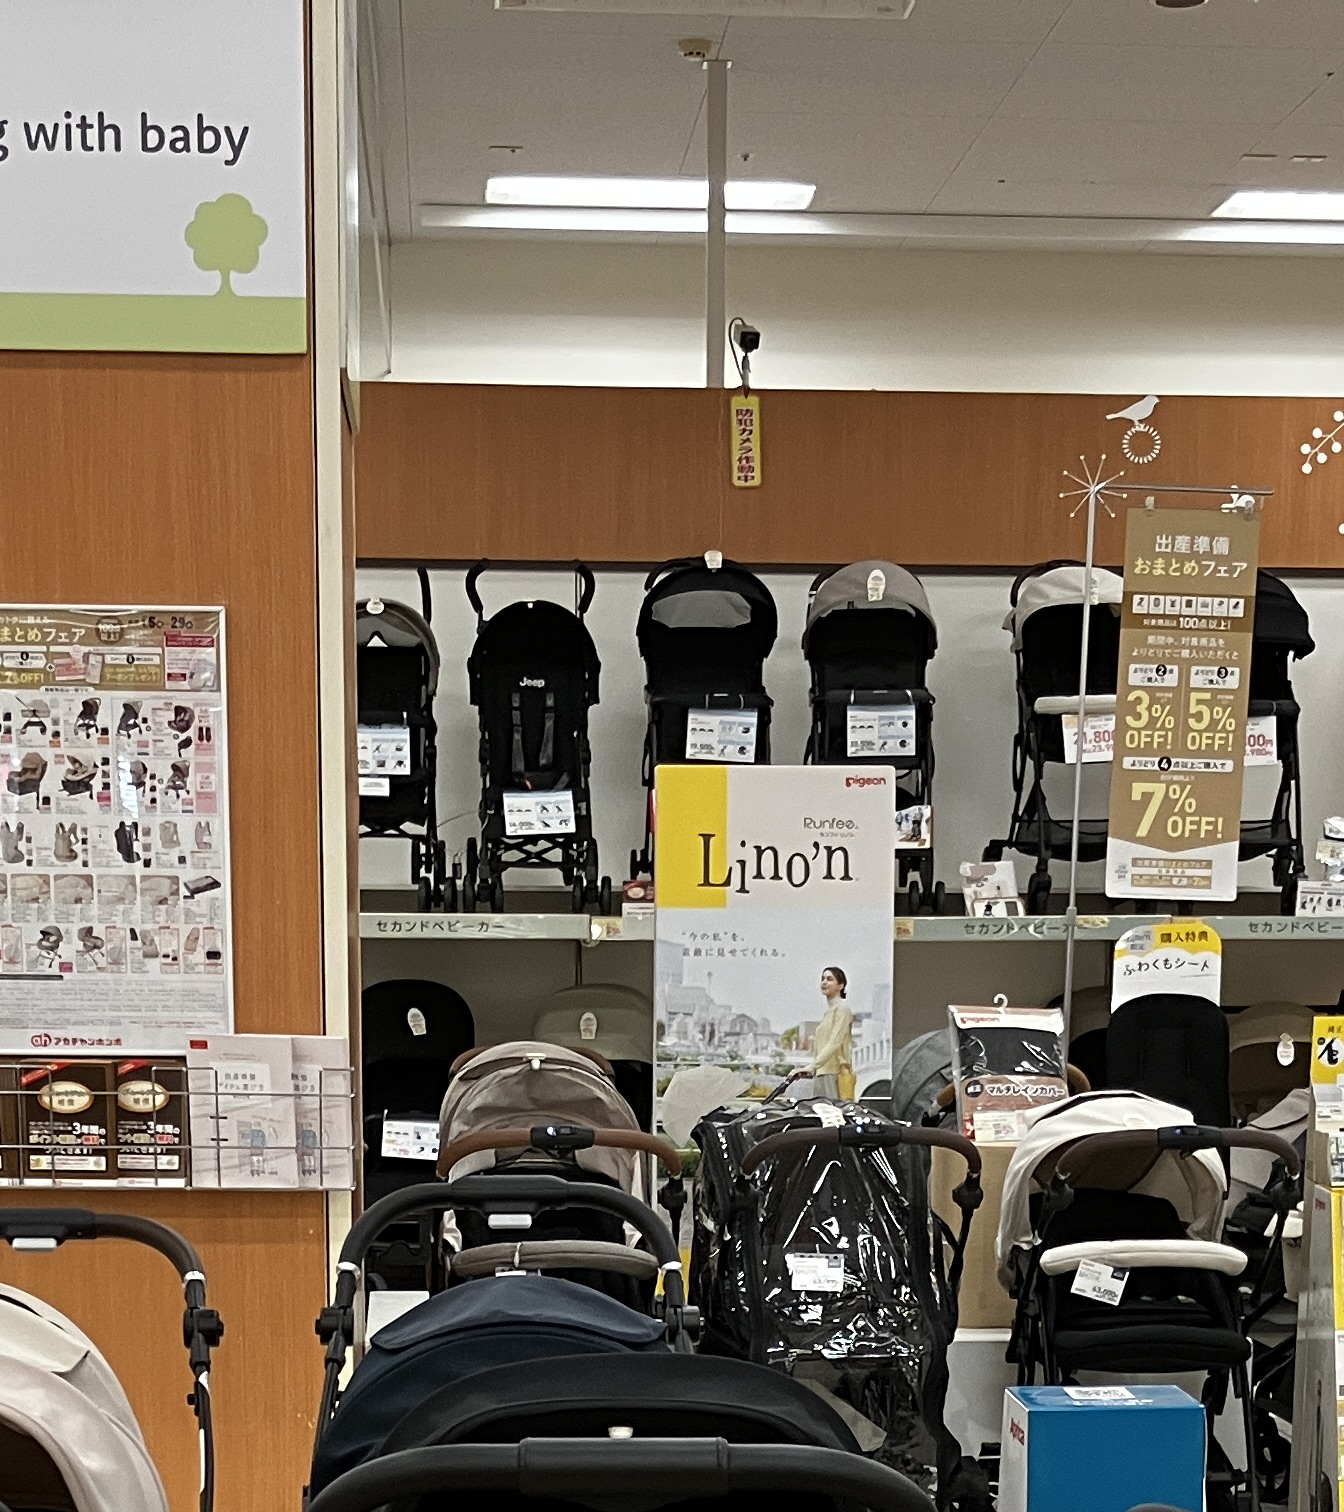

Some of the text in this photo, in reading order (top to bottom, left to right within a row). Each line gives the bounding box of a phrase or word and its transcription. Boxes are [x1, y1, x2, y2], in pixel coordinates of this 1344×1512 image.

[23, 111, 123, 153] with
[141, 111, 250, 166] baby
[1155, 534, 1230, 555] 出産準備
[1133, 557, 1248, 578] おまとめフェア
[1125, 690, 1175, 729] 3%
[1187, 691, 1236, 731] 5%
[1125, 730, 1173, 749] OFF!
[1186, 732, 1233, 751] OFF!
[845, 775, 887, 788] pigeon
[1131, 782, 1197, 838] 7%
[1166, 816, 1224, 839] OFF!
[376, 918, 506, 934] セカンドベビーカー
